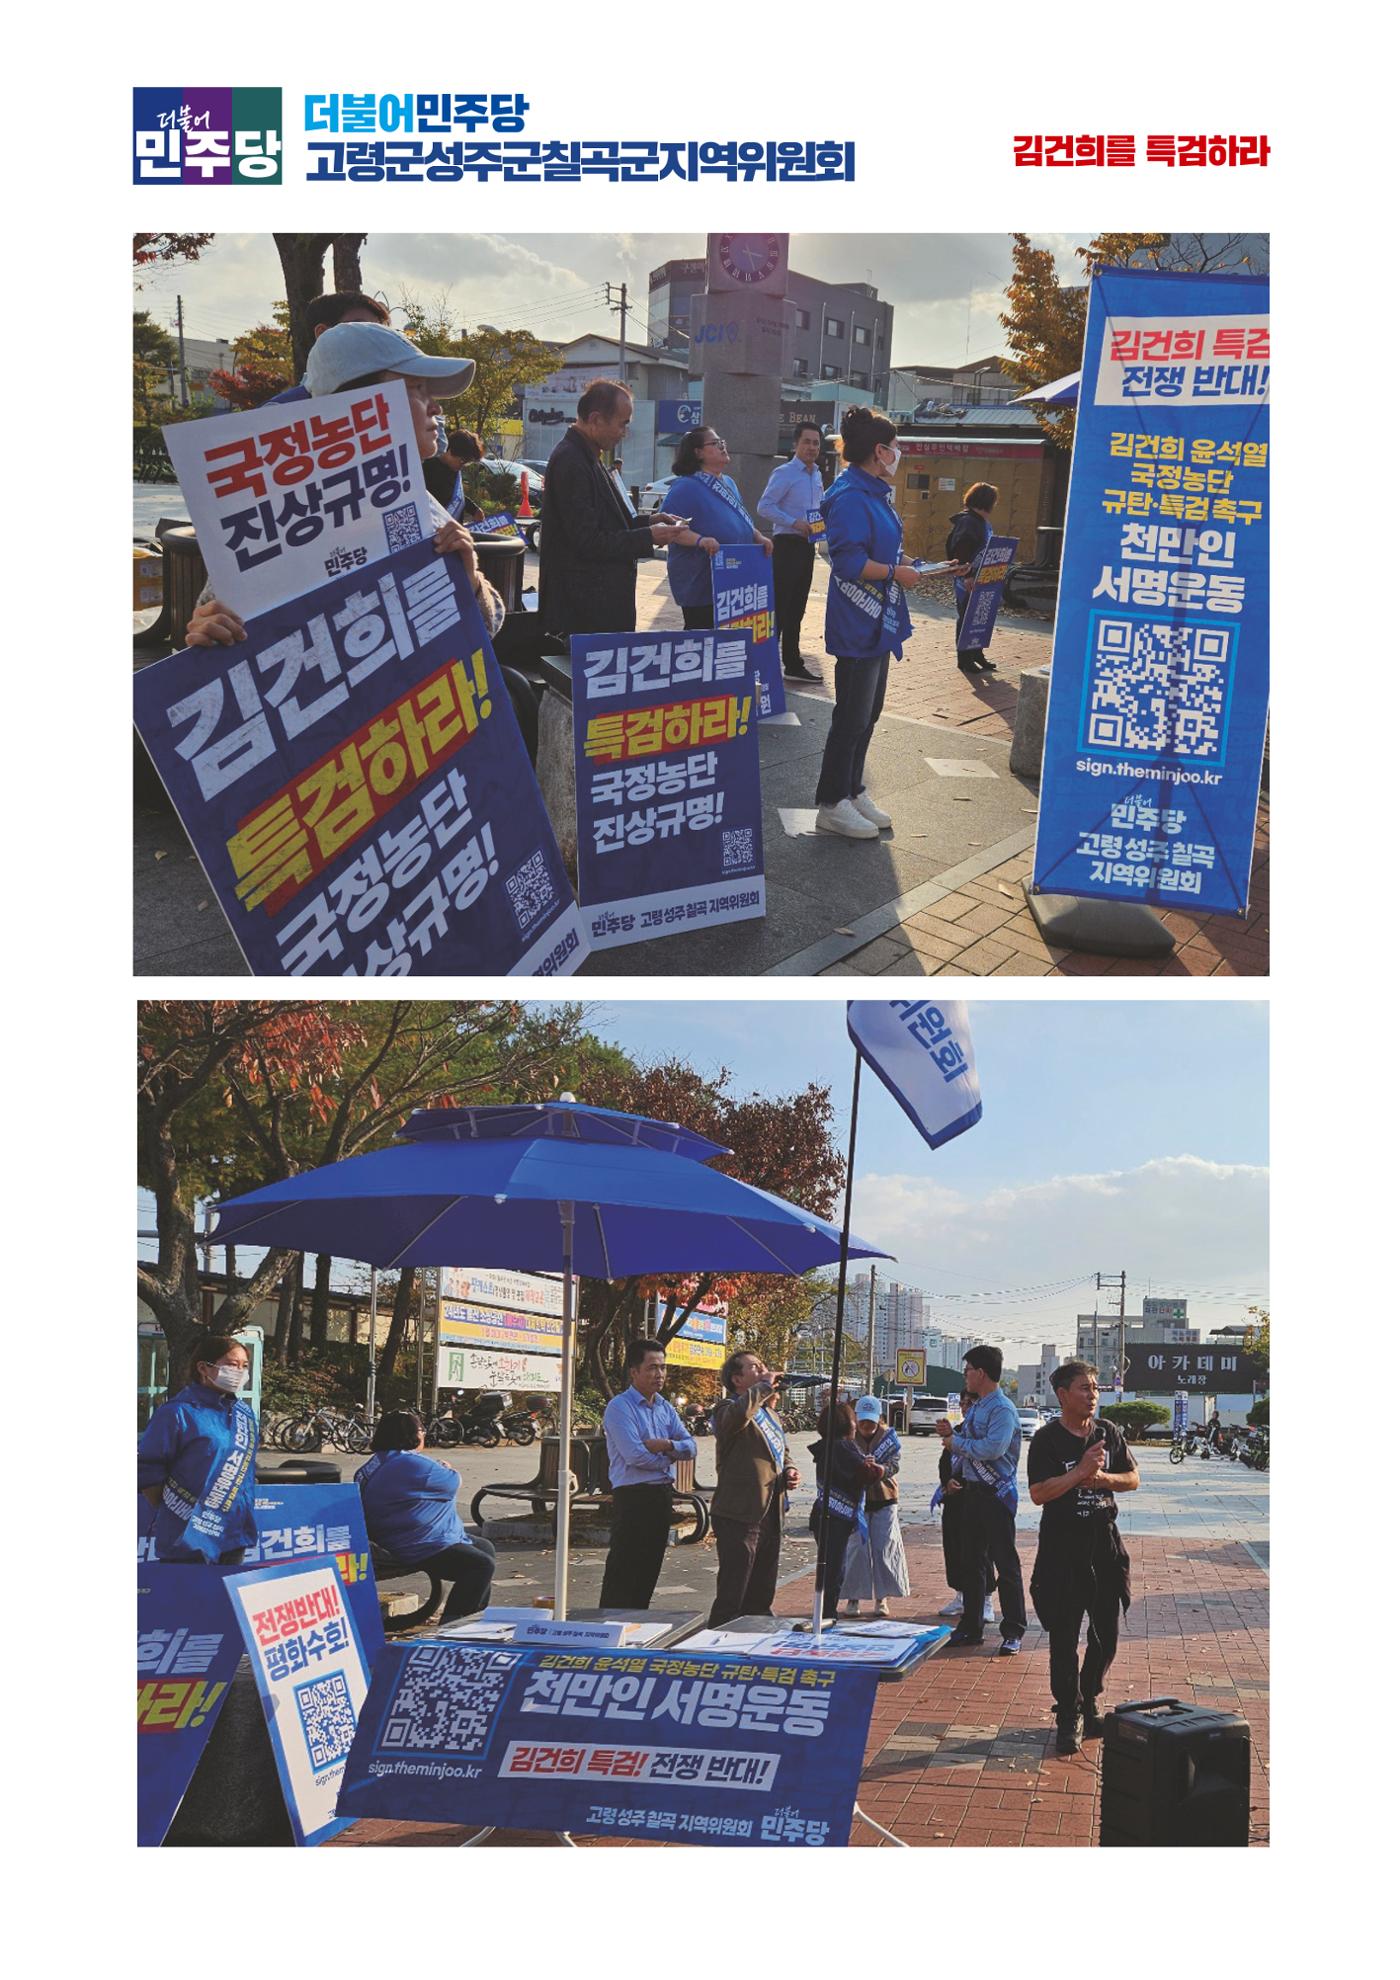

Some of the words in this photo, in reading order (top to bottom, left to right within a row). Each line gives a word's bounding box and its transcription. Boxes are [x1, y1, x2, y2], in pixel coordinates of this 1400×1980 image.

[694, 323, 724, 344] JCI
[1111, 330, 1206, 361] 김건희
[1122, 366, 1186, 397] 전쟁
[1192, 364, 1270, 396] 반대!
[204, 393, 392, 498] 국정농단
[1110, 432, 1185, 461] 김건희
[1191, 439, 1268, 467] 윤석열
[1131, 463, 1234, 494] 국정농단
[220, 443, 411, 573] 진상규명!
[1212, 498, 1263, 526] 촉구
[324, 547, 368, 577] 민주당
[1120, 522, 1236, 568] 천만인
[716, 583, 769, 621] 김건희를
[1092, 565, 1246, 614] 서명운동
[166, 557, 461, 801] 김건희를
[583, 637, 747, 699] 김건희를
[584, 696, 752, 759] 특검하라!
[226, 648, 492, 912] 특검하라!
[591, 751, 718, 805] 국정농단
[1076, 757, 1223, 785] sign.theminjoo.kr
[593, 791, 724, 854] 진상규명!
[1111, 803, 1187, 834] 민주당
[1076, 832, 1123, 859] 고령
[1124, 837, 1169, 862] 성주
[1172, 842, 1215, 869] 칠곡
[276, 768, 472, 976] 국정농단
[1089, 861, 1202, 894] 지역위원회
[343, 822, 499, 976] 상규명!
[592, 914, 635, 937] 민주당
[641, 907, 664, 928] 고령
[663, 904, 686, 924] 성주
[686, 900, 707, 919] 칠곡
[709, 890, 760, 913] 지역위원회
[1148, 1354, 1237, 1372] 아카데미
[252, 1584, 340, 1647] 전쟁반대!
[264, 1615, 349, 1682] 평화수호!
[539, 1655, 592, 1670] 김건희
[593, 1656, 647, 1673] 윤석열
[649, 1658, 718, 1679] 국정농단
[721, 1664, 796, 1686] 규탄·특검
[800, 1667, 836, 1687] 촉구
[520, 1670, 657, 1721] 천만인
[652, 1680, 831, 1737] 서명운동
[369, 1760, 483, 1780] sign.theminjoo.kr
[509, 1746, 585, 1775] 김건희
[588, 1749, 650, 1777] 특검!
[650, 1752, 700, 1780] 전쟁
[704, 1755, 771, 1785] 반대!
[586, 1806, 617, 1825] 고령
[618, 1809, 646, 1827] 성주
[647, 1811, 677, 1830] 칠곡
[678, 1814, 753, 1838] 지역위원회
[760, 1814, 831, 1846] 민주당
